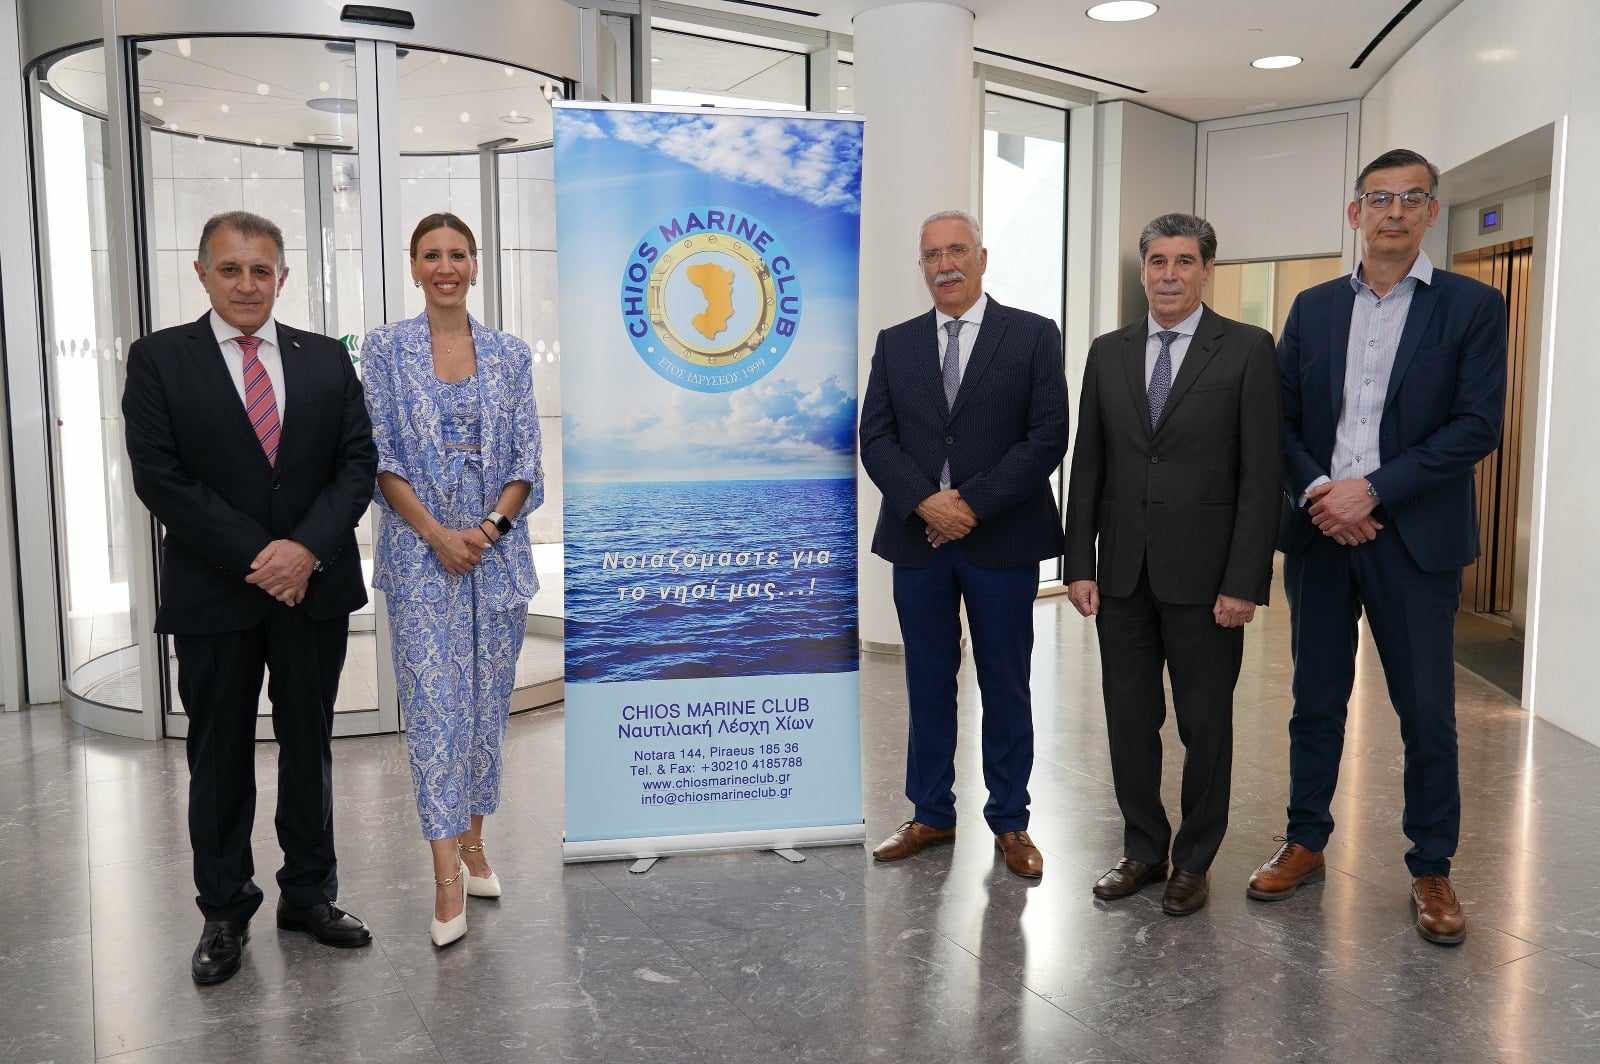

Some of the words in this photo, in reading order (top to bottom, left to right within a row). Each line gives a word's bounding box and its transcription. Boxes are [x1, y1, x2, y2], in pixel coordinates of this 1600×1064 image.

[624, 242, 657, 338] CHIOS
[659, 210, 774, 253] MARINE
[772, 256, 799, 337] CLUB
[603, 549, 779, 573] Νοιαζόμαστε
[793, 550, 831, 569] για
[618, 586, 645, 601] το
[660, 580, 718, 603] νησί
[623, 704, 680, 720] CHIOS
[688, 701, 755, 717] MARINE
[762, 698, 809, 714] CLUB
[618, 720, 712, 739] Ναυτιλιακή
[718, 718, 769, 735] Λέσχη
[776, 716, 814, 730] Χίων
[634, 750, 675, 761] Notara
[681, 749, 705, 759] 144,
[711, 746, 754, 757] Piraeus
[760, 744, 779, 754] 185
[784, 743, 799, 753] 36
[631, 765, 652, 776] Tel.
[657, 765, 666, 774] &
[670, 763, 695, 774] Fax:
[702, 761, 747, 772] +30210
[752, 758, 802, 769] 4185788
[643, 772, 791, 790] www.chiosmarineclub.gr
[641, 787, 792, 805] info@chiosmarineclub.gr
